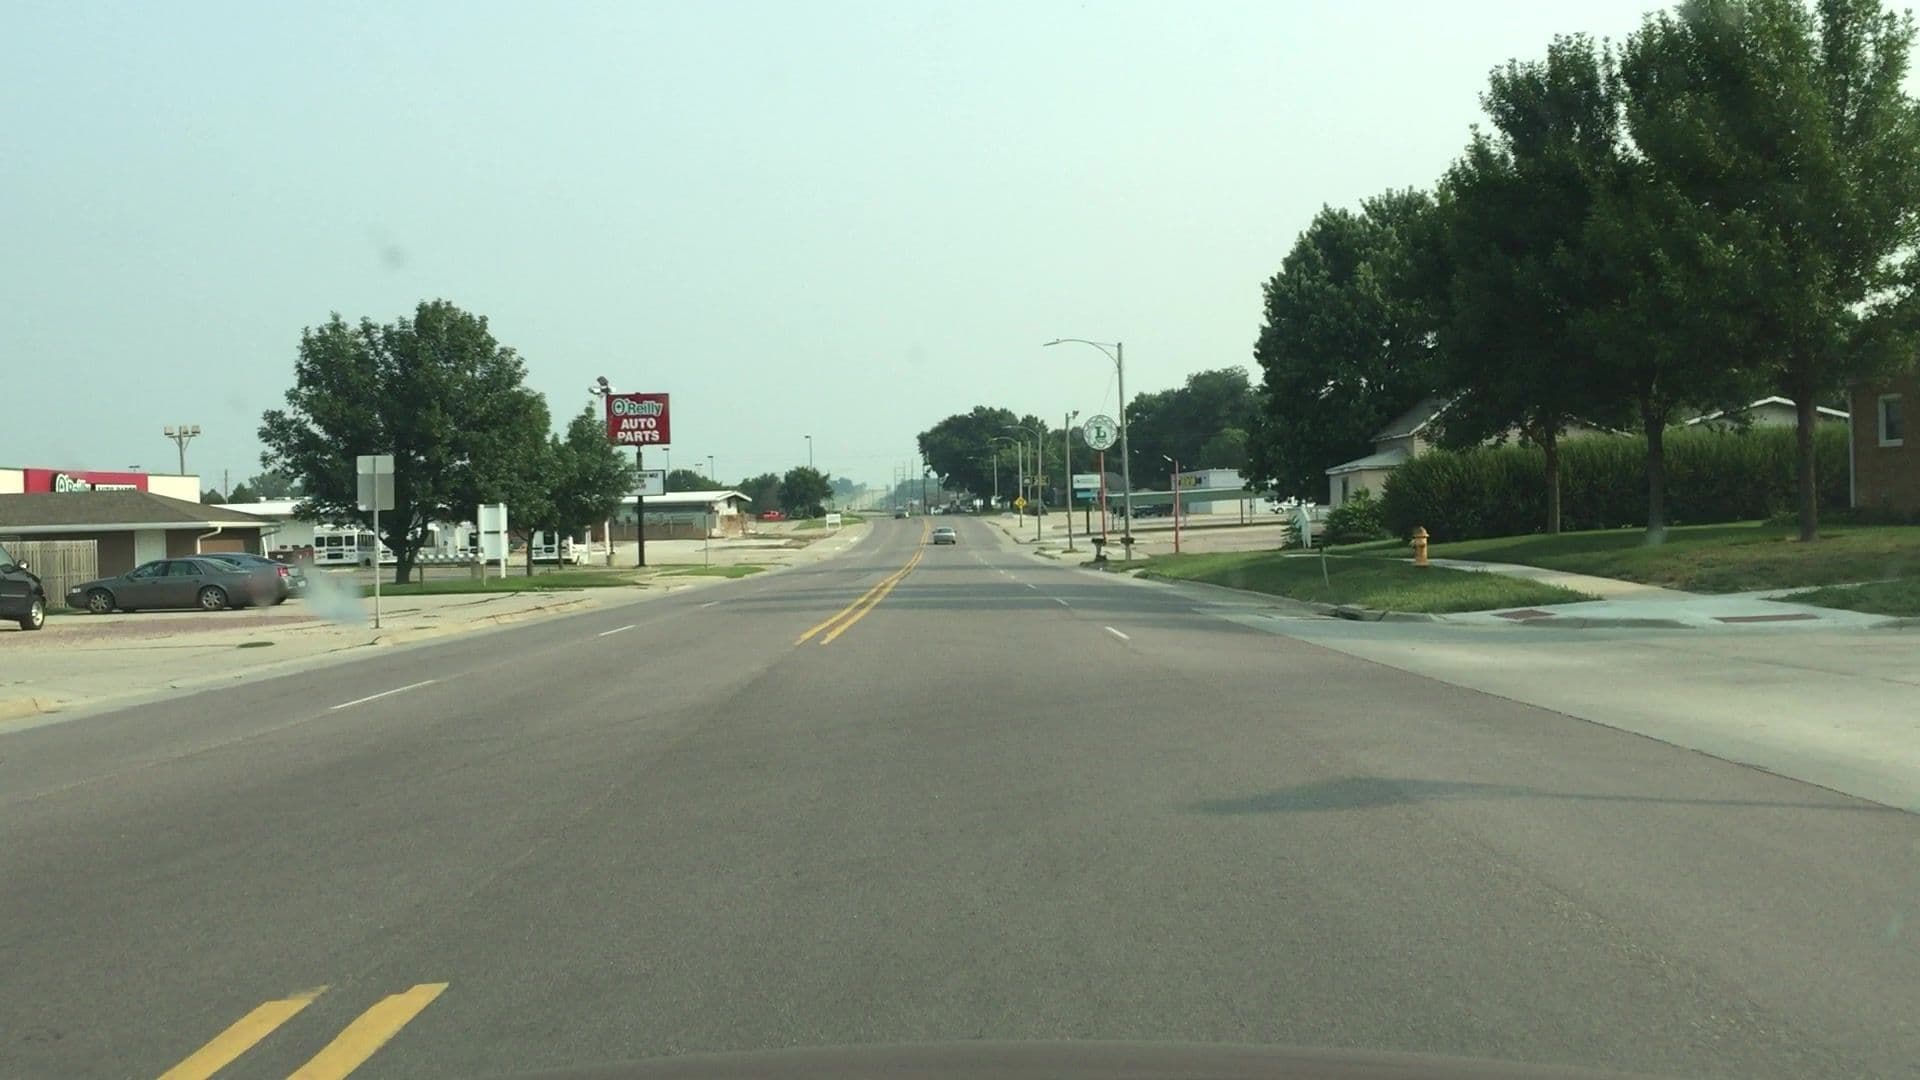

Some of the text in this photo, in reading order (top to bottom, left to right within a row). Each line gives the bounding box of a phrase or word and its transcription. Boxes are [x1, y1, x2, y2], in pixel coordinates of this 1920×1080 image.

[612, 398, 663, 416] O'Reilly
[621, 418, 656, 430] AUTO
[617, 430, 660, 442] PARTS
